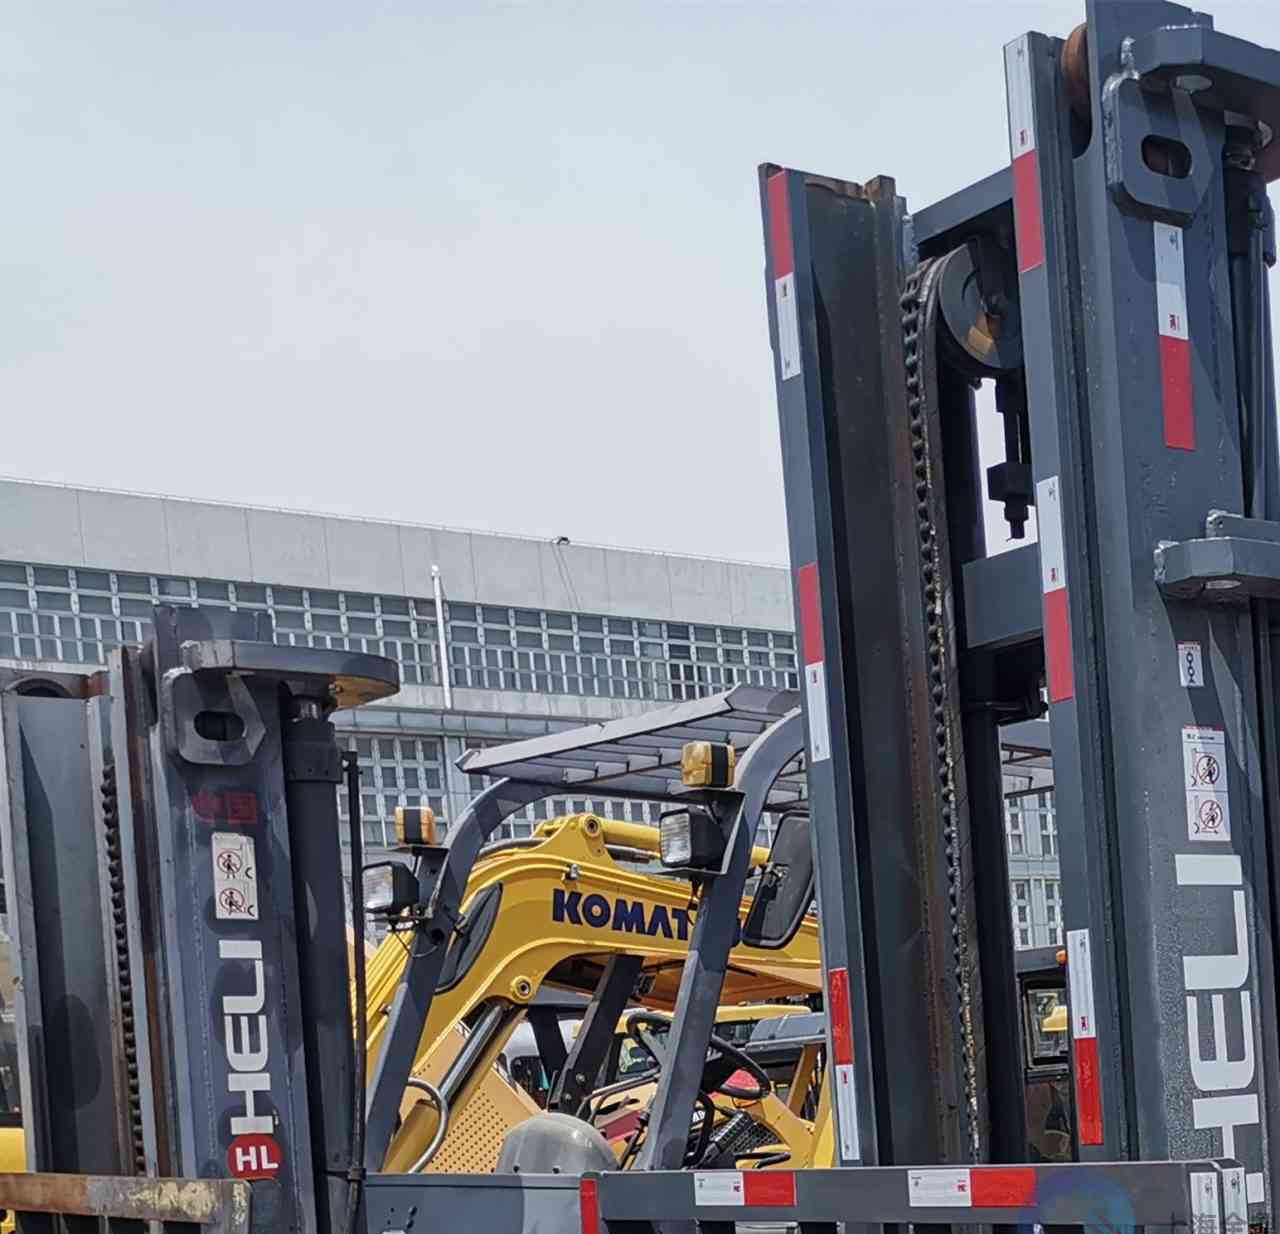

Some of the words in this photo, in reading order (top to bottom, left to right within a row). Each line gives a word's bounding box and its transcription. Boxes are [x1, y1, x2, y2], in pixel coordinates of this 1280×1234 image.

[553, 888, 742, 945] KOMAT
[219, 939, 274, 1134] HELI
[1175, 854, 1264, 1203] HELI
[235, 1143, 280, 1170] HL
